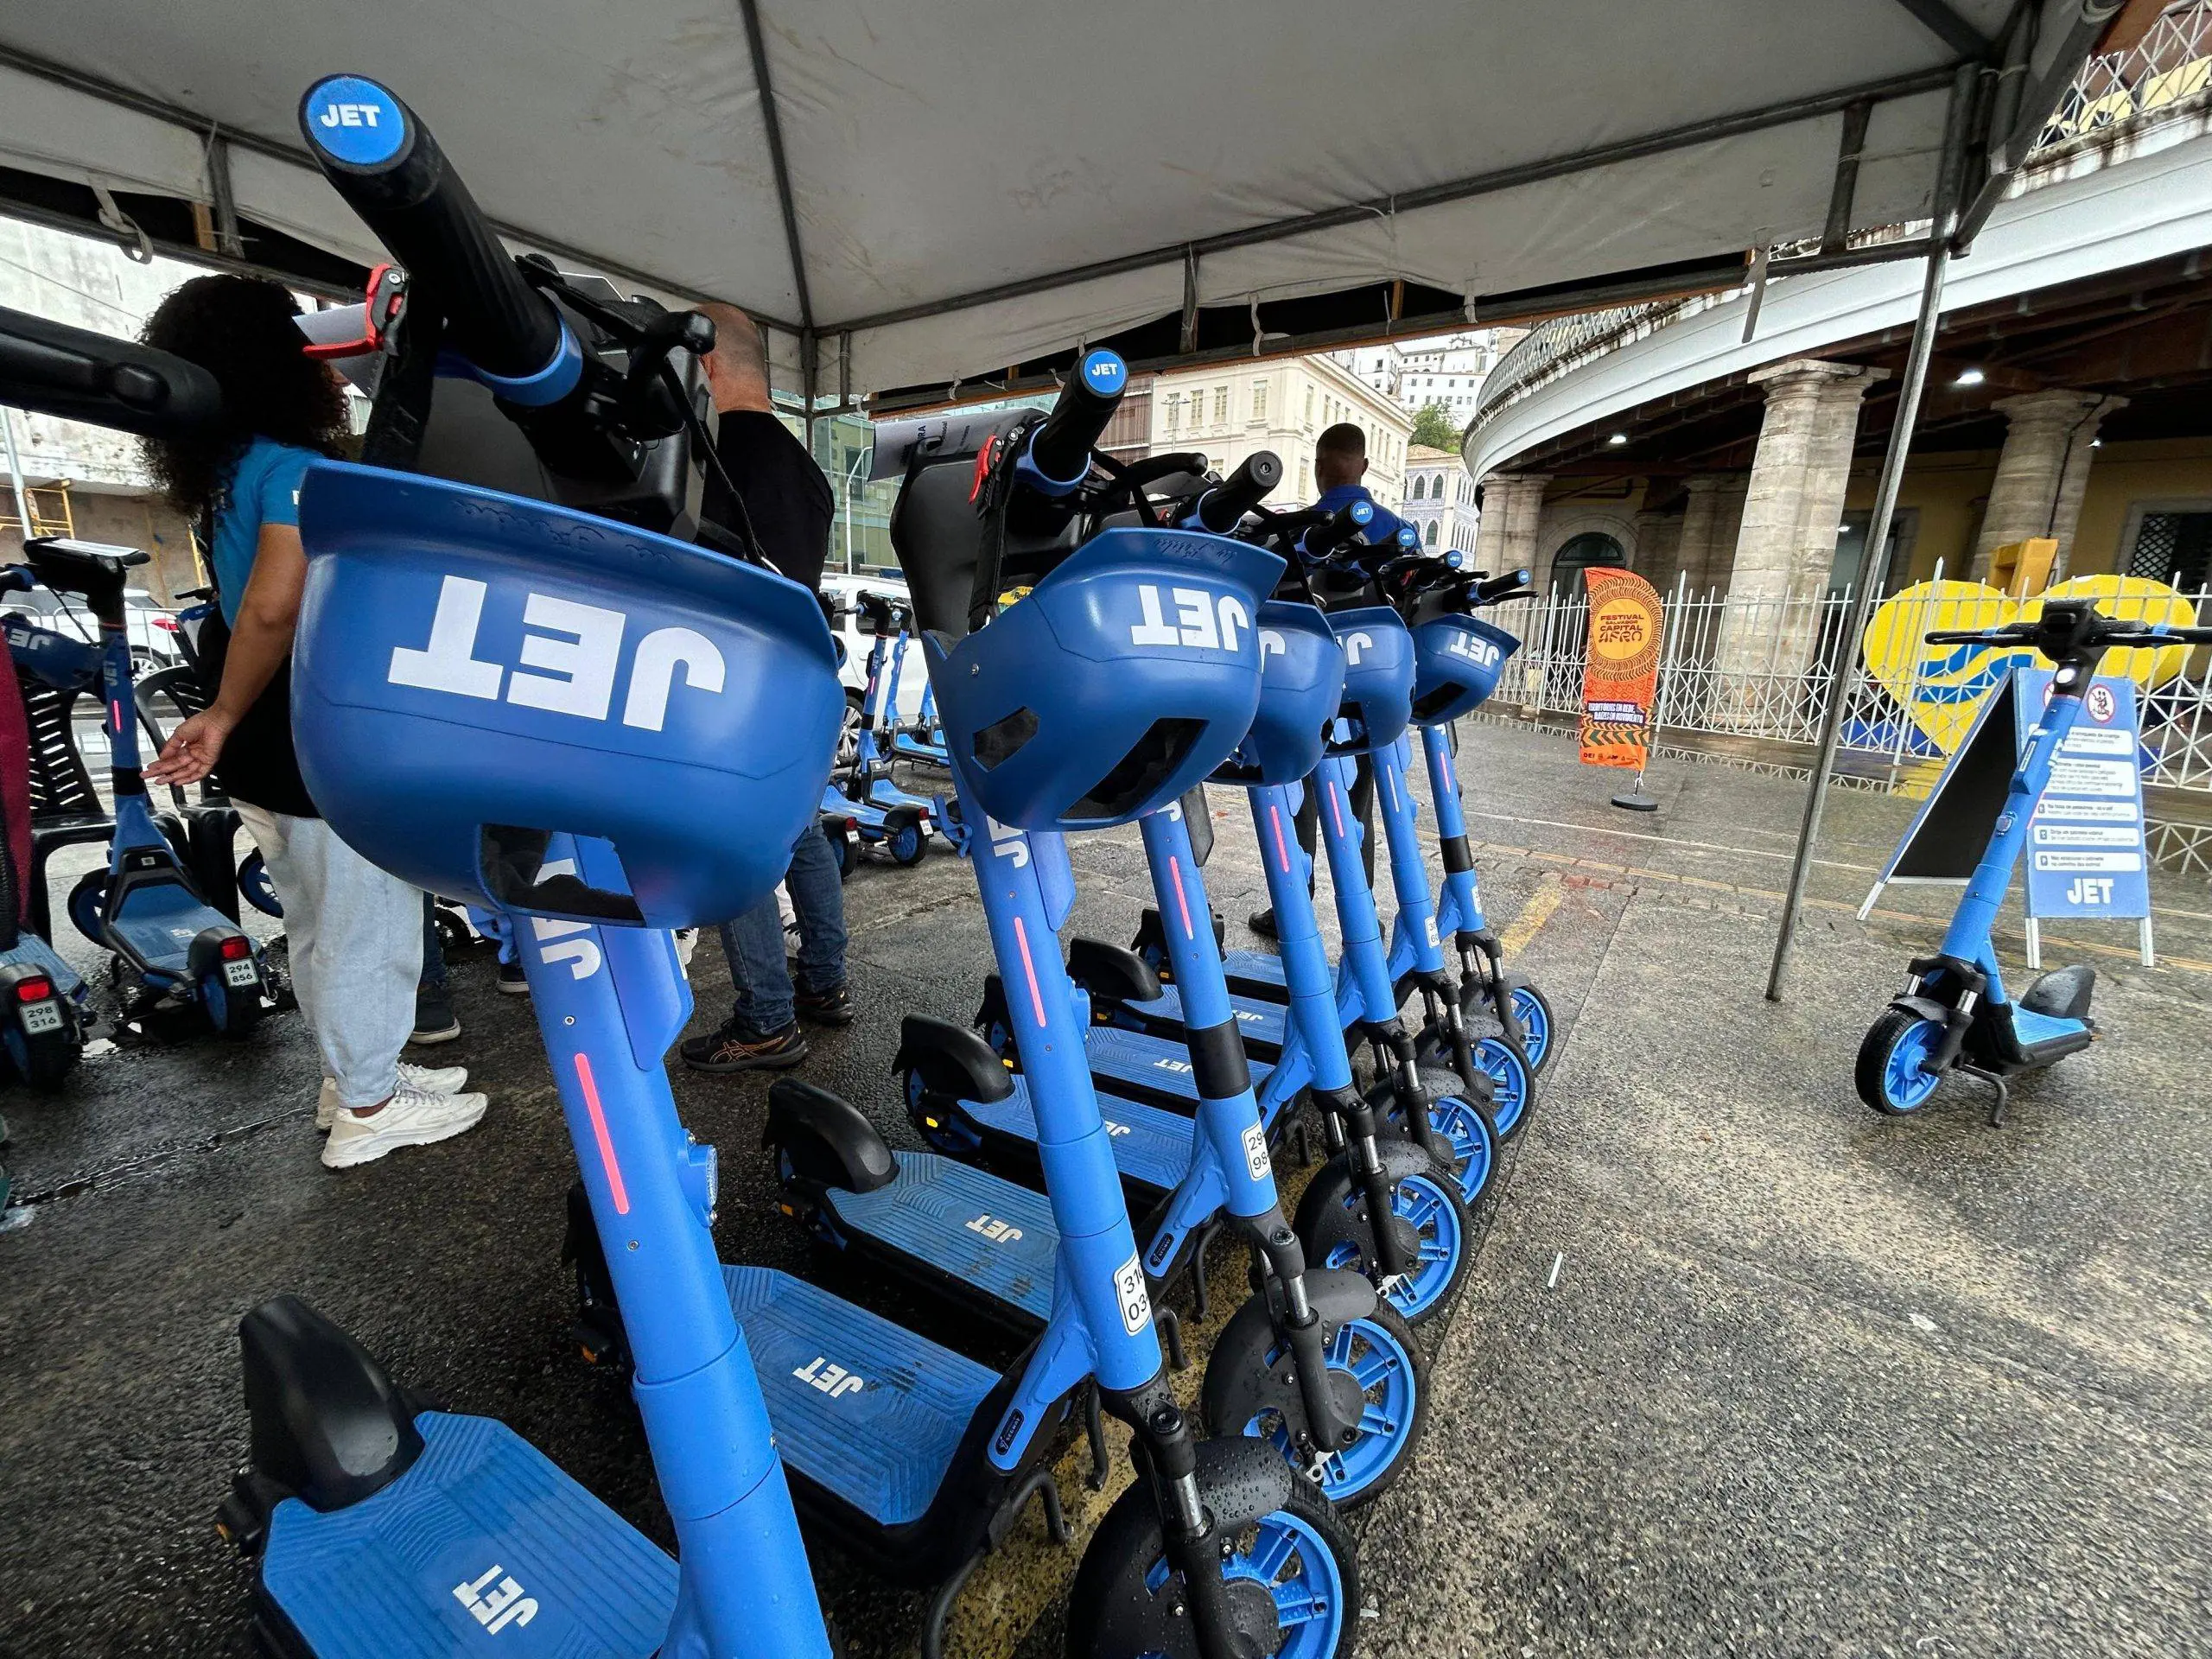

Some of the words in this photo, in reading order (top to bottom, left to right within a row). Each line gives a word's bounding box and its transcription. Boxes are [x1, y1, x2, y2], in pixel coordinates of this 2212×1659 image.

[320, 104, 381, 128] JET
[1091, 363, 1118, 376] JET
[1357, 507, 1370, 516] JET
[1130, 584, 1249, 652] JET
[8, 627, 52, 650] JE
[1599, 631, 1643, 643] AFRO
[387, 574, 726, 733] JET
[1450, 631, 1500, 667] JET
[2066, 877, 2114, 905] JET
[229, 963, 250, 973] 294
[232, 973, 253, 983] 856
[28, 1006, 53, 1018] 298
[30, 1016, 57, 1028] 316
[1104, 1120, 1131, 1136] JE
[964, 1214, 1023, 1243] JET
[791, 1356, 864, 1399] JET
[452, 1564, 539, 1636] JET
